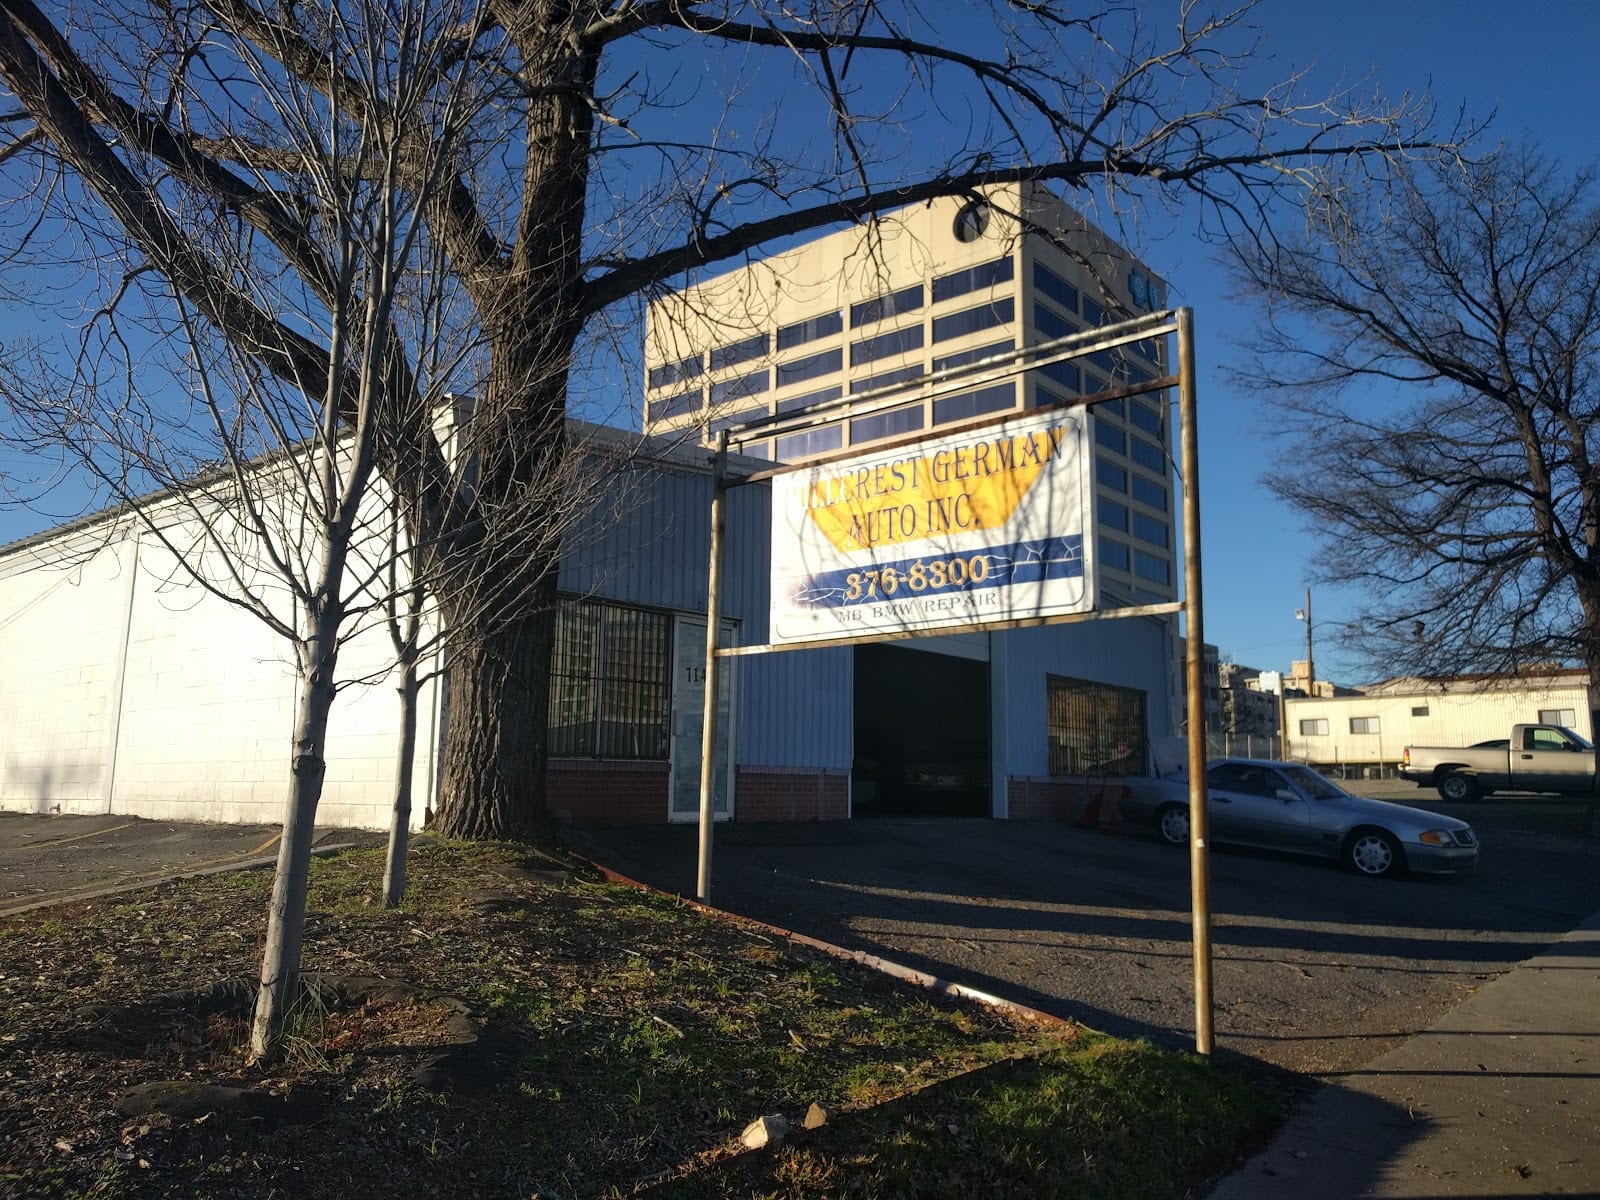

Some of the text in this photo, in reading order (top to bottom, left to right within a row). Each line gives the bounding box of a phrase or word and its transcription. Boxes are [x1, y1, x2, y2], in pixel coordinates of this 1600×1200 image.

[932, 424, 1064, 483] GERMAN
[846, 493, 980, 547] AUTO INC.
[845, 554, 989, 600] 376-8300
[838, 592, 997, 623] MB BMW REPAIR
